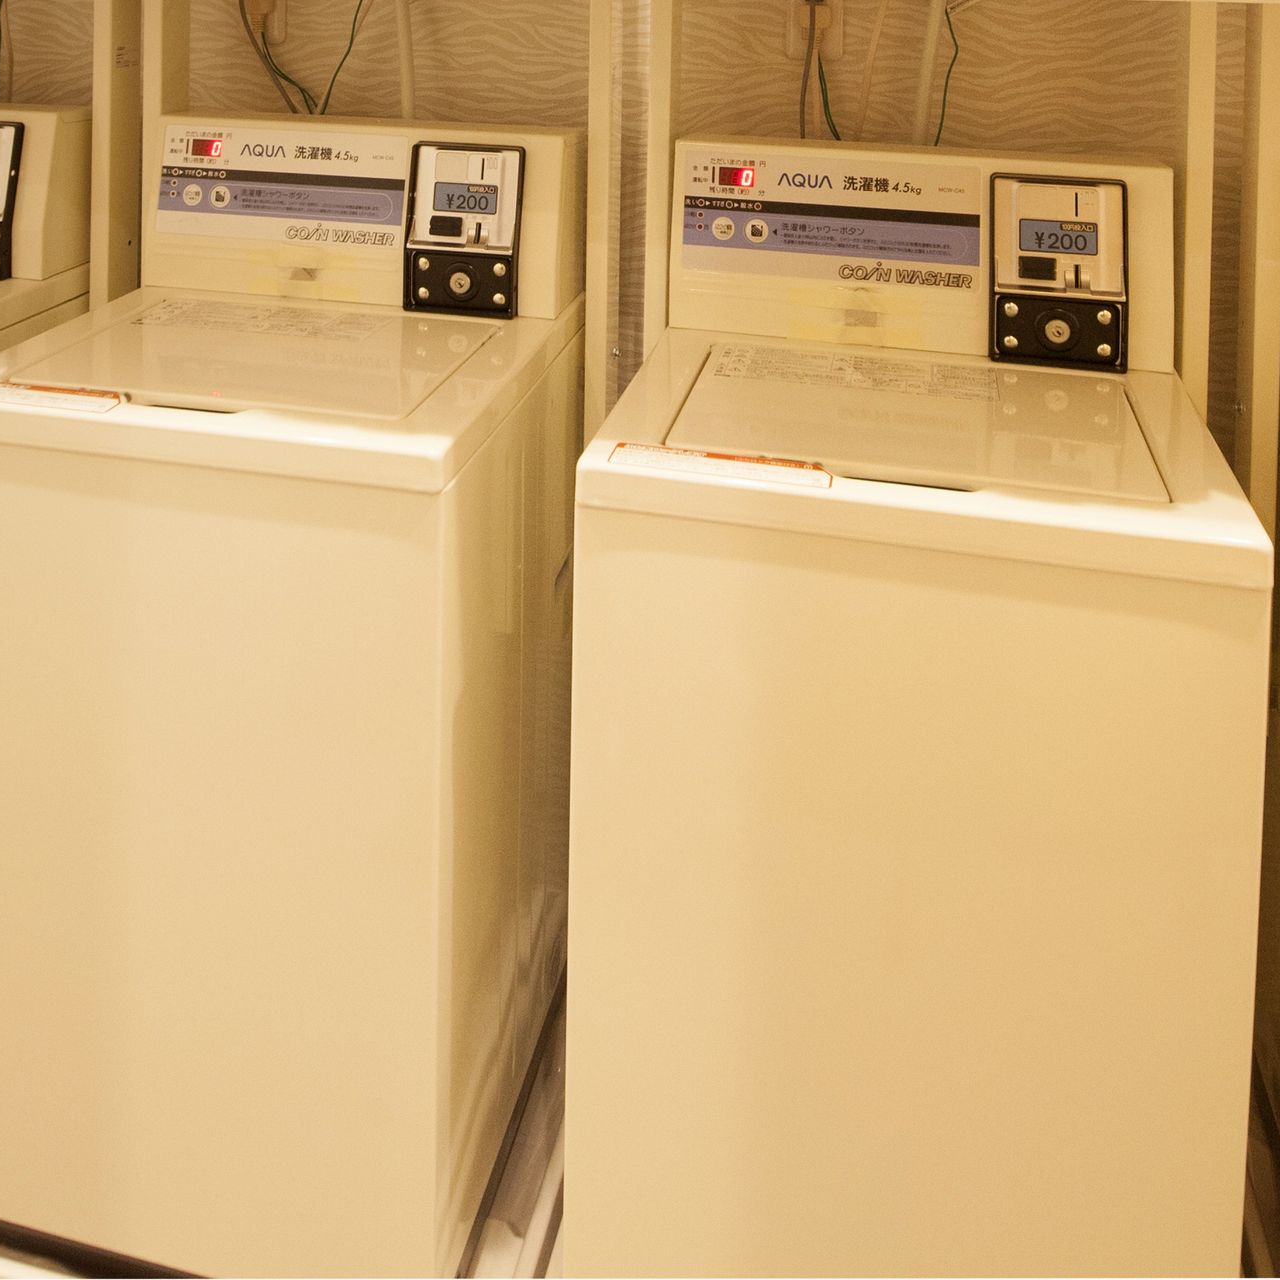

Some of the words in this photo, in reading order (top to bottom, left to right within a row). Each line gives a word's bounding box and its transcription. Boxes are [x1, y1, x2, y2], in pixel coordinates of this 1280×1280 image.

[211, 141, 222, 156] 0
[240, 143, 286, 158] AQUA
[294, 145, 333, 161] 洗濯機
[334, 150, 359, 162] 4.5kg
[741, 169, 753, 186] 0
[777, 172, 833, 190] AQUA
[843, 175, 890, 193] 洗濯機
[892, 182, 922, 195] 4.5kg
[446, 193, 489, 211] ¥200
[332, 229, 394, 246] WASHER
[1034, 231, 1087, 251] ¥200
[895, 268, 972, 289] WASHER
